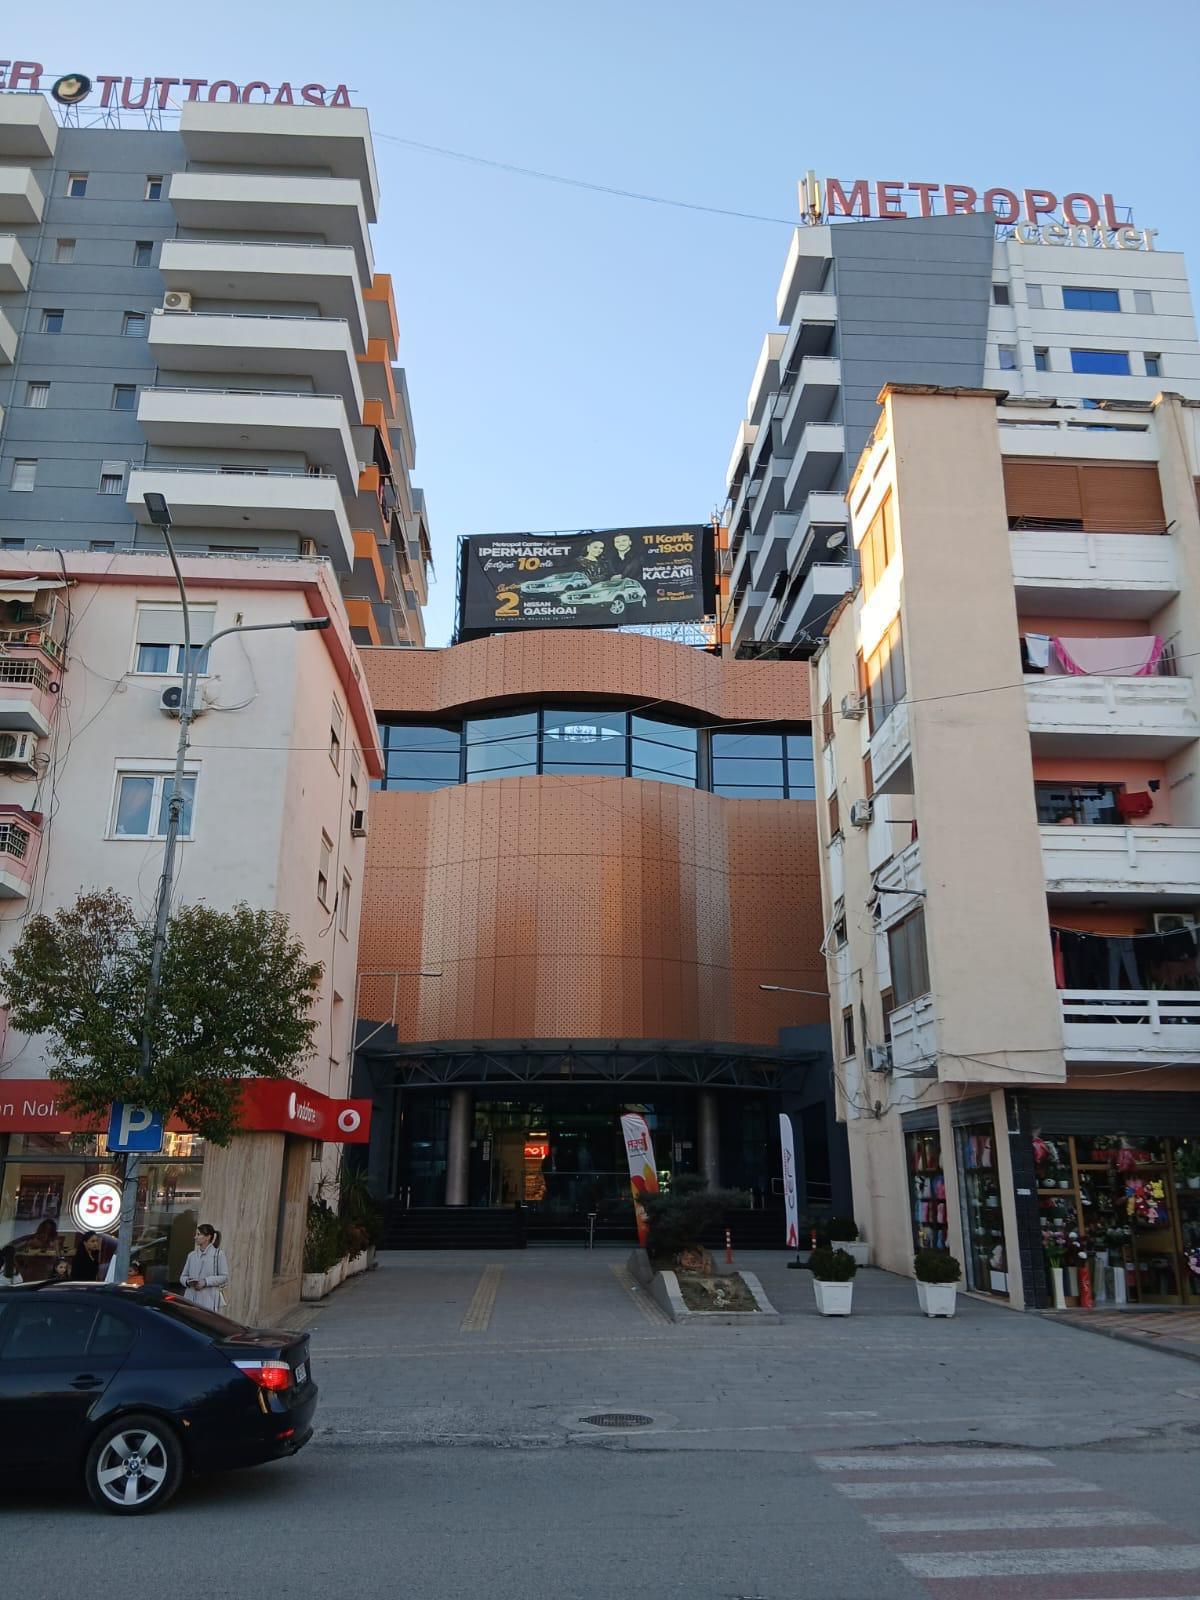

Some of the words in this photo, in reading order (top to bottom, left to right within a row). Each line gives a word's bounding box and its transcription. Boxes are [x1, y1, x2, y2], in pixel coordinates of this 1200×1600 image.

[97, 75, 351, 108] TUTTOCASA
[826, 178, 1134, 230] METROPOL
[1014, 220, 1159, 251] center
[478, 546, 571, 557] IPERMARKET
[658, 543, 693, 553] 19:00
[517, 557, 540, 570] 10
[495, 592, 519, 617] 2
[523, 606, 577, 616] QASHQAI
[0, 1104, 14, 1116] n
[118, 1105, 153, 1145] P
[86, 1196, 113, 1214] 5G
